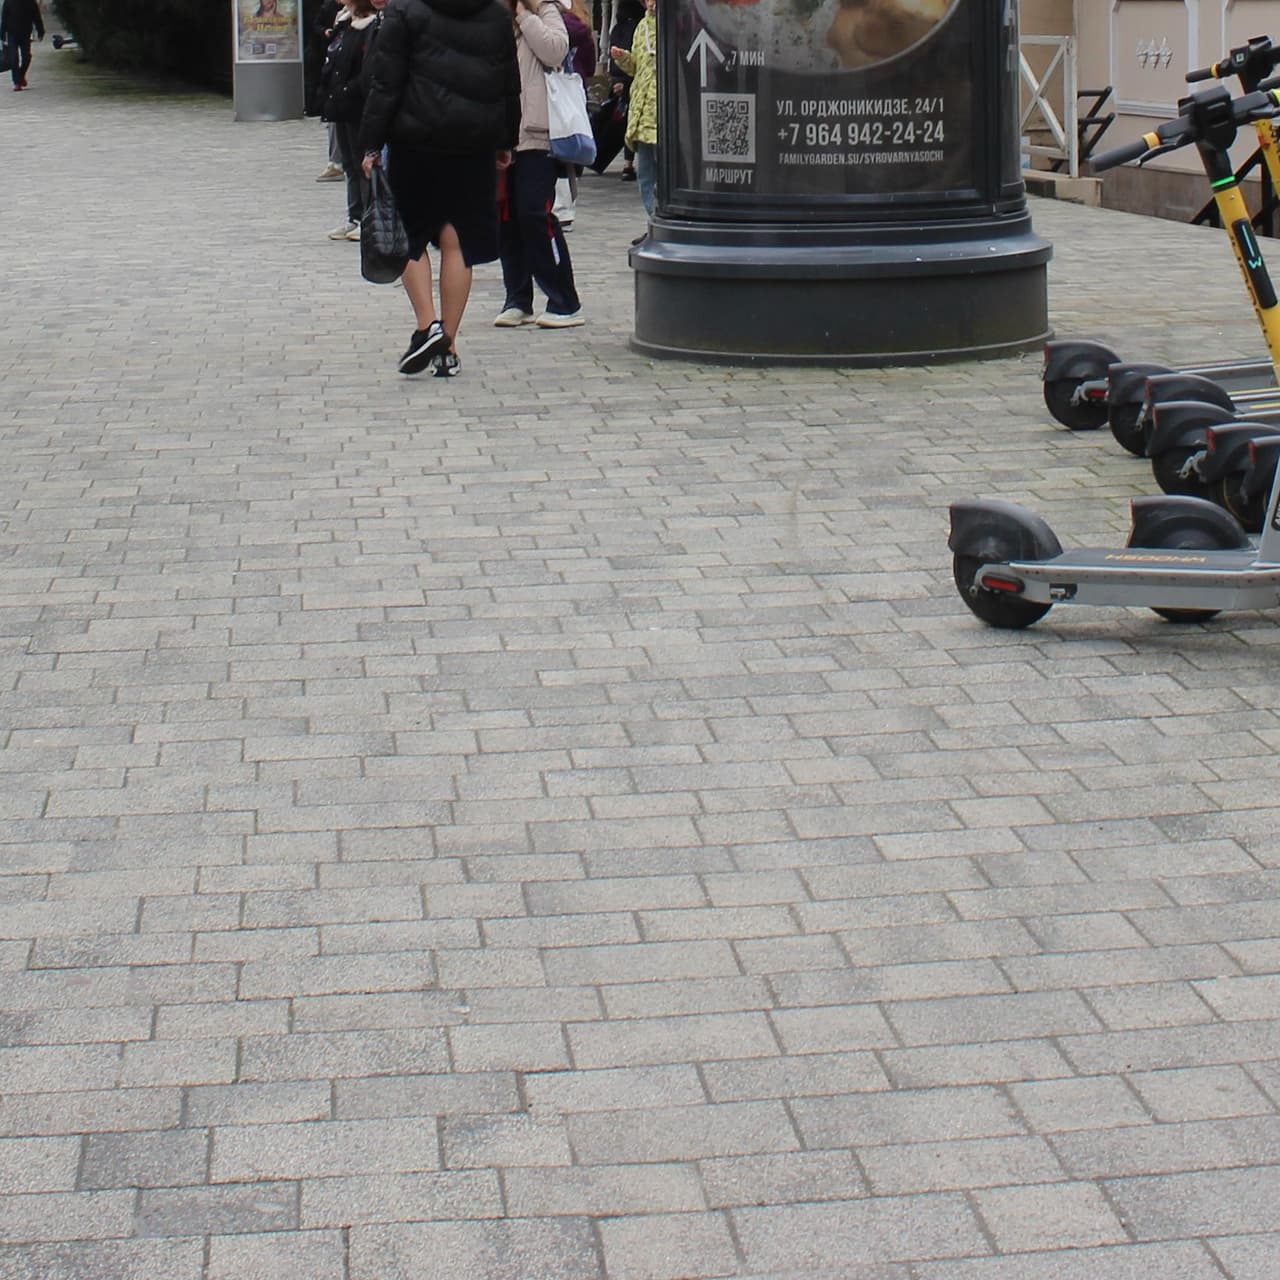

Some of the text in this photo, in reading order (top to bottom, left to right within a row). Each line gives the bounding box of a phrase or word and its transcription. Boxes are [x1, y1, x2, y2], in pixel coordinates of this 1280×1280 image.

[740, 50, 765, 66] МИН
[776, 97, 944, 118] УЛ. ОРДЖОНИКИДЗЕ, 24/1
[777, 120, 945, 146] +7 964 942-24-24
[706, 168, 753, 185] МАРШРУТ
